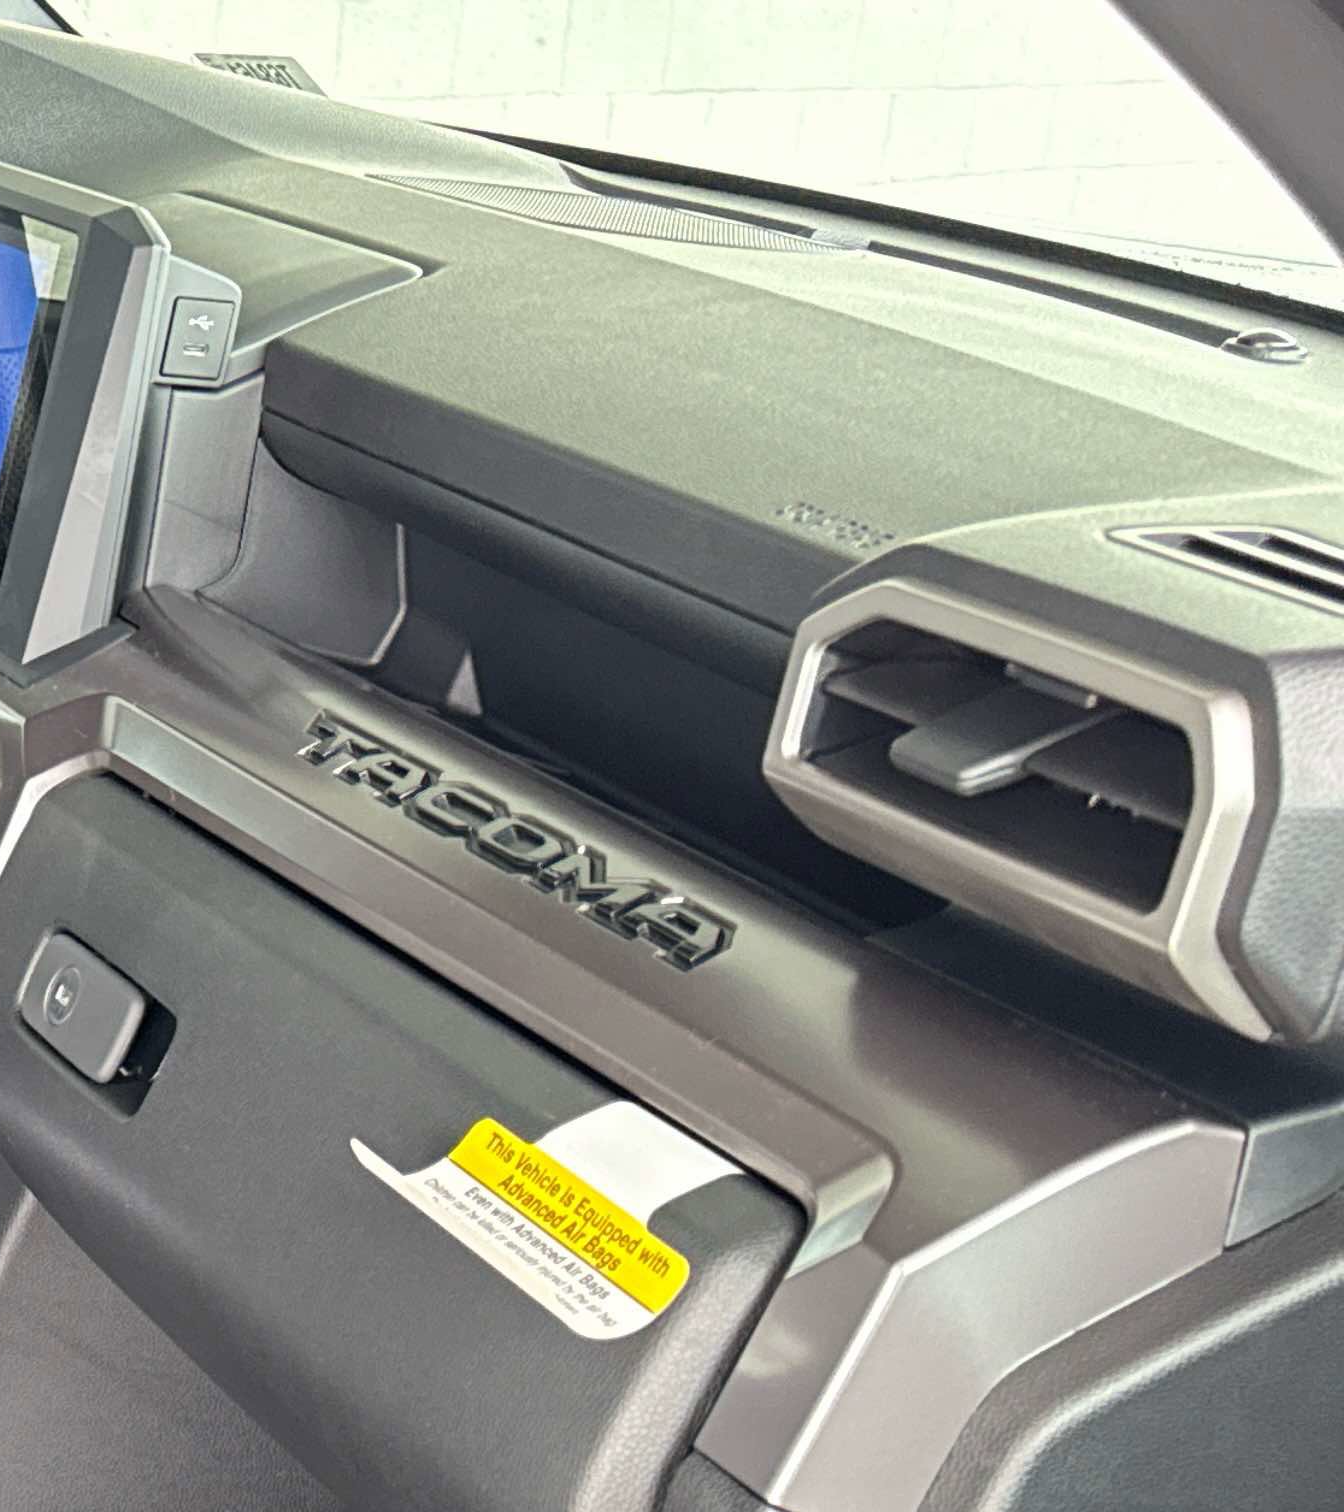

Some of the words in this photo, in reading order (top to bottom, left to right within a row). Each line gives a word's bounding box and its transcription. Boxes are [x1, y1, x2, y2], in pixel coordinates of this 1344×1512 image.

[296, 708, 738, 974] TACOMA
[465, 1186, 492, 1211] Even
[493, 1204, 514, 1225] with
[513, 1219, 566, 1265] Advanced
[566, 1260, 583, 1280] Air
[581, 1272, 609, 1300] Bags
[487, 1133, 514, 1164] This
[515, 1154, 561, 1196] Vehicle
[575, 1198, 637, 1254] Equipped
[639, 1245, 671, 1277] with
[498, 1173, 567, 1229] Advanced
[564, 1219, 584, 1243] Air
[586, 1236, 621, 1273] Bags
